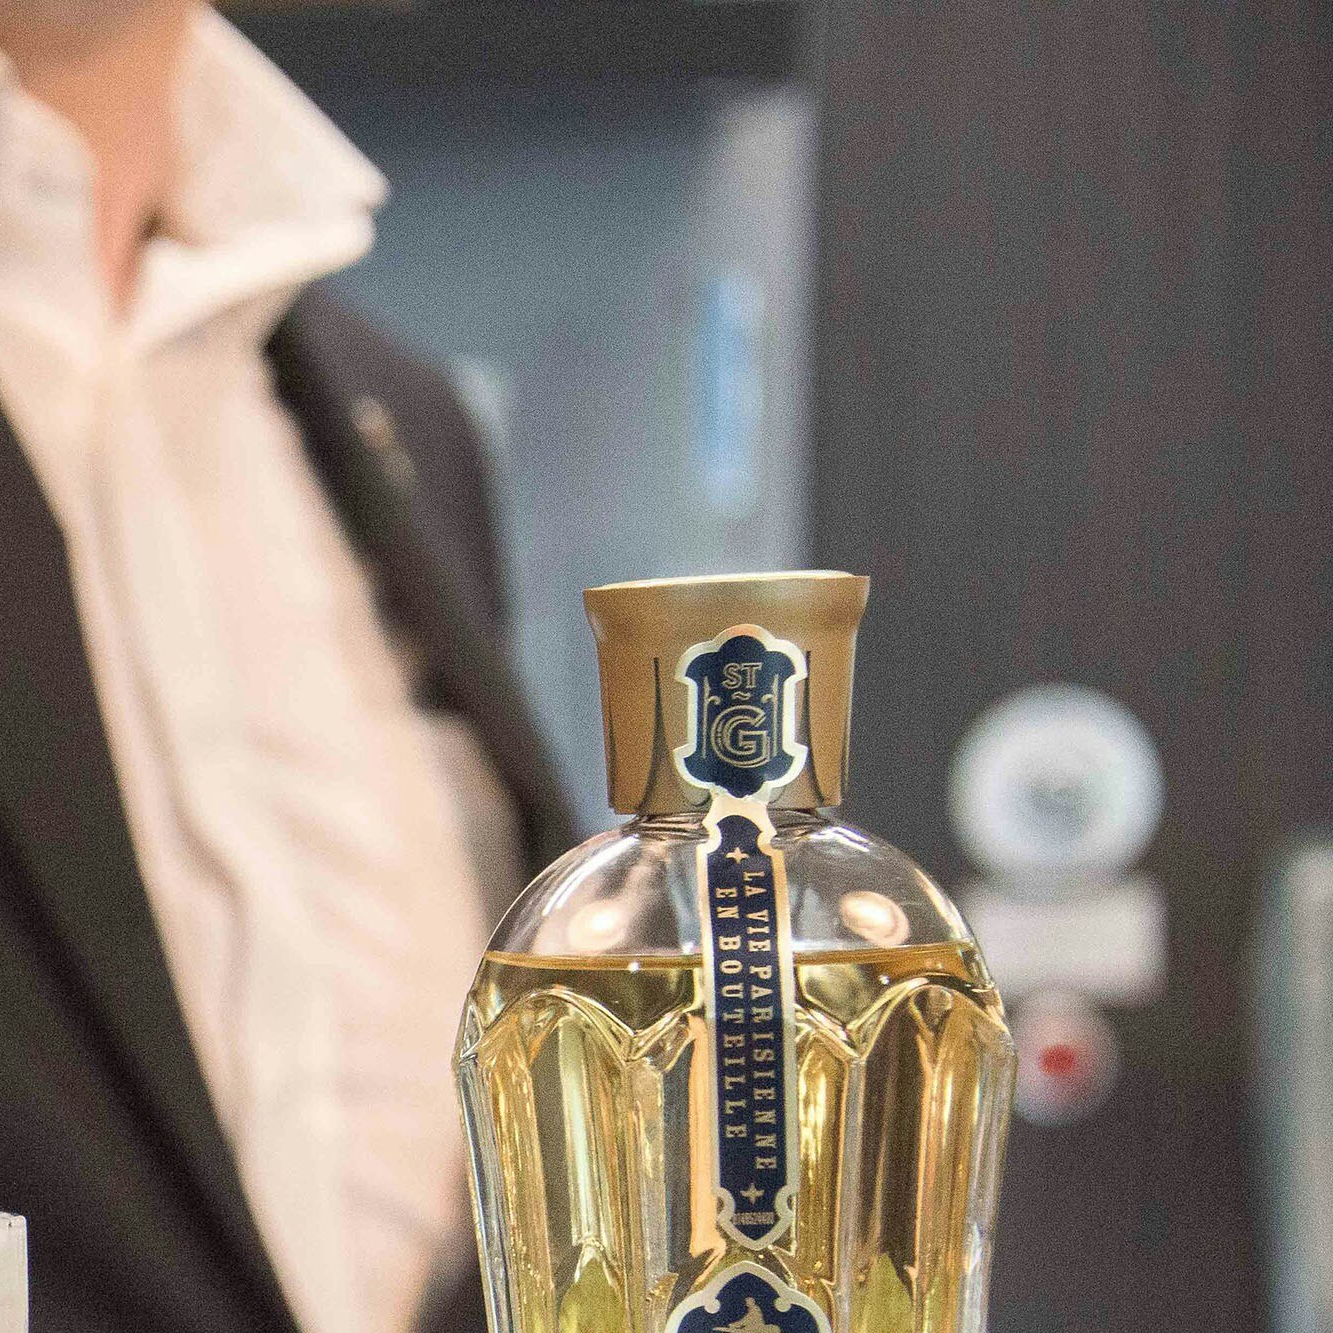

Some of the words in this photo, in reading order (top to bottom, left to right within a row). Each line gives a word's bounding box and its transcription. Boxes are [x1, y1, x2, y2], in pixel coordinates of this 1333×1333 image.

[722, 662, 763, 690] ST
[710, 704, 771, 768] G
[713, 887, 738, 921] EN
[742, 868, 765, 899] LA
[745, 905, 772, 953] VIE
[717, 935, 748, 1140] BOUTEILLE
[749, 964, 778, 1172] PARISIENNE
